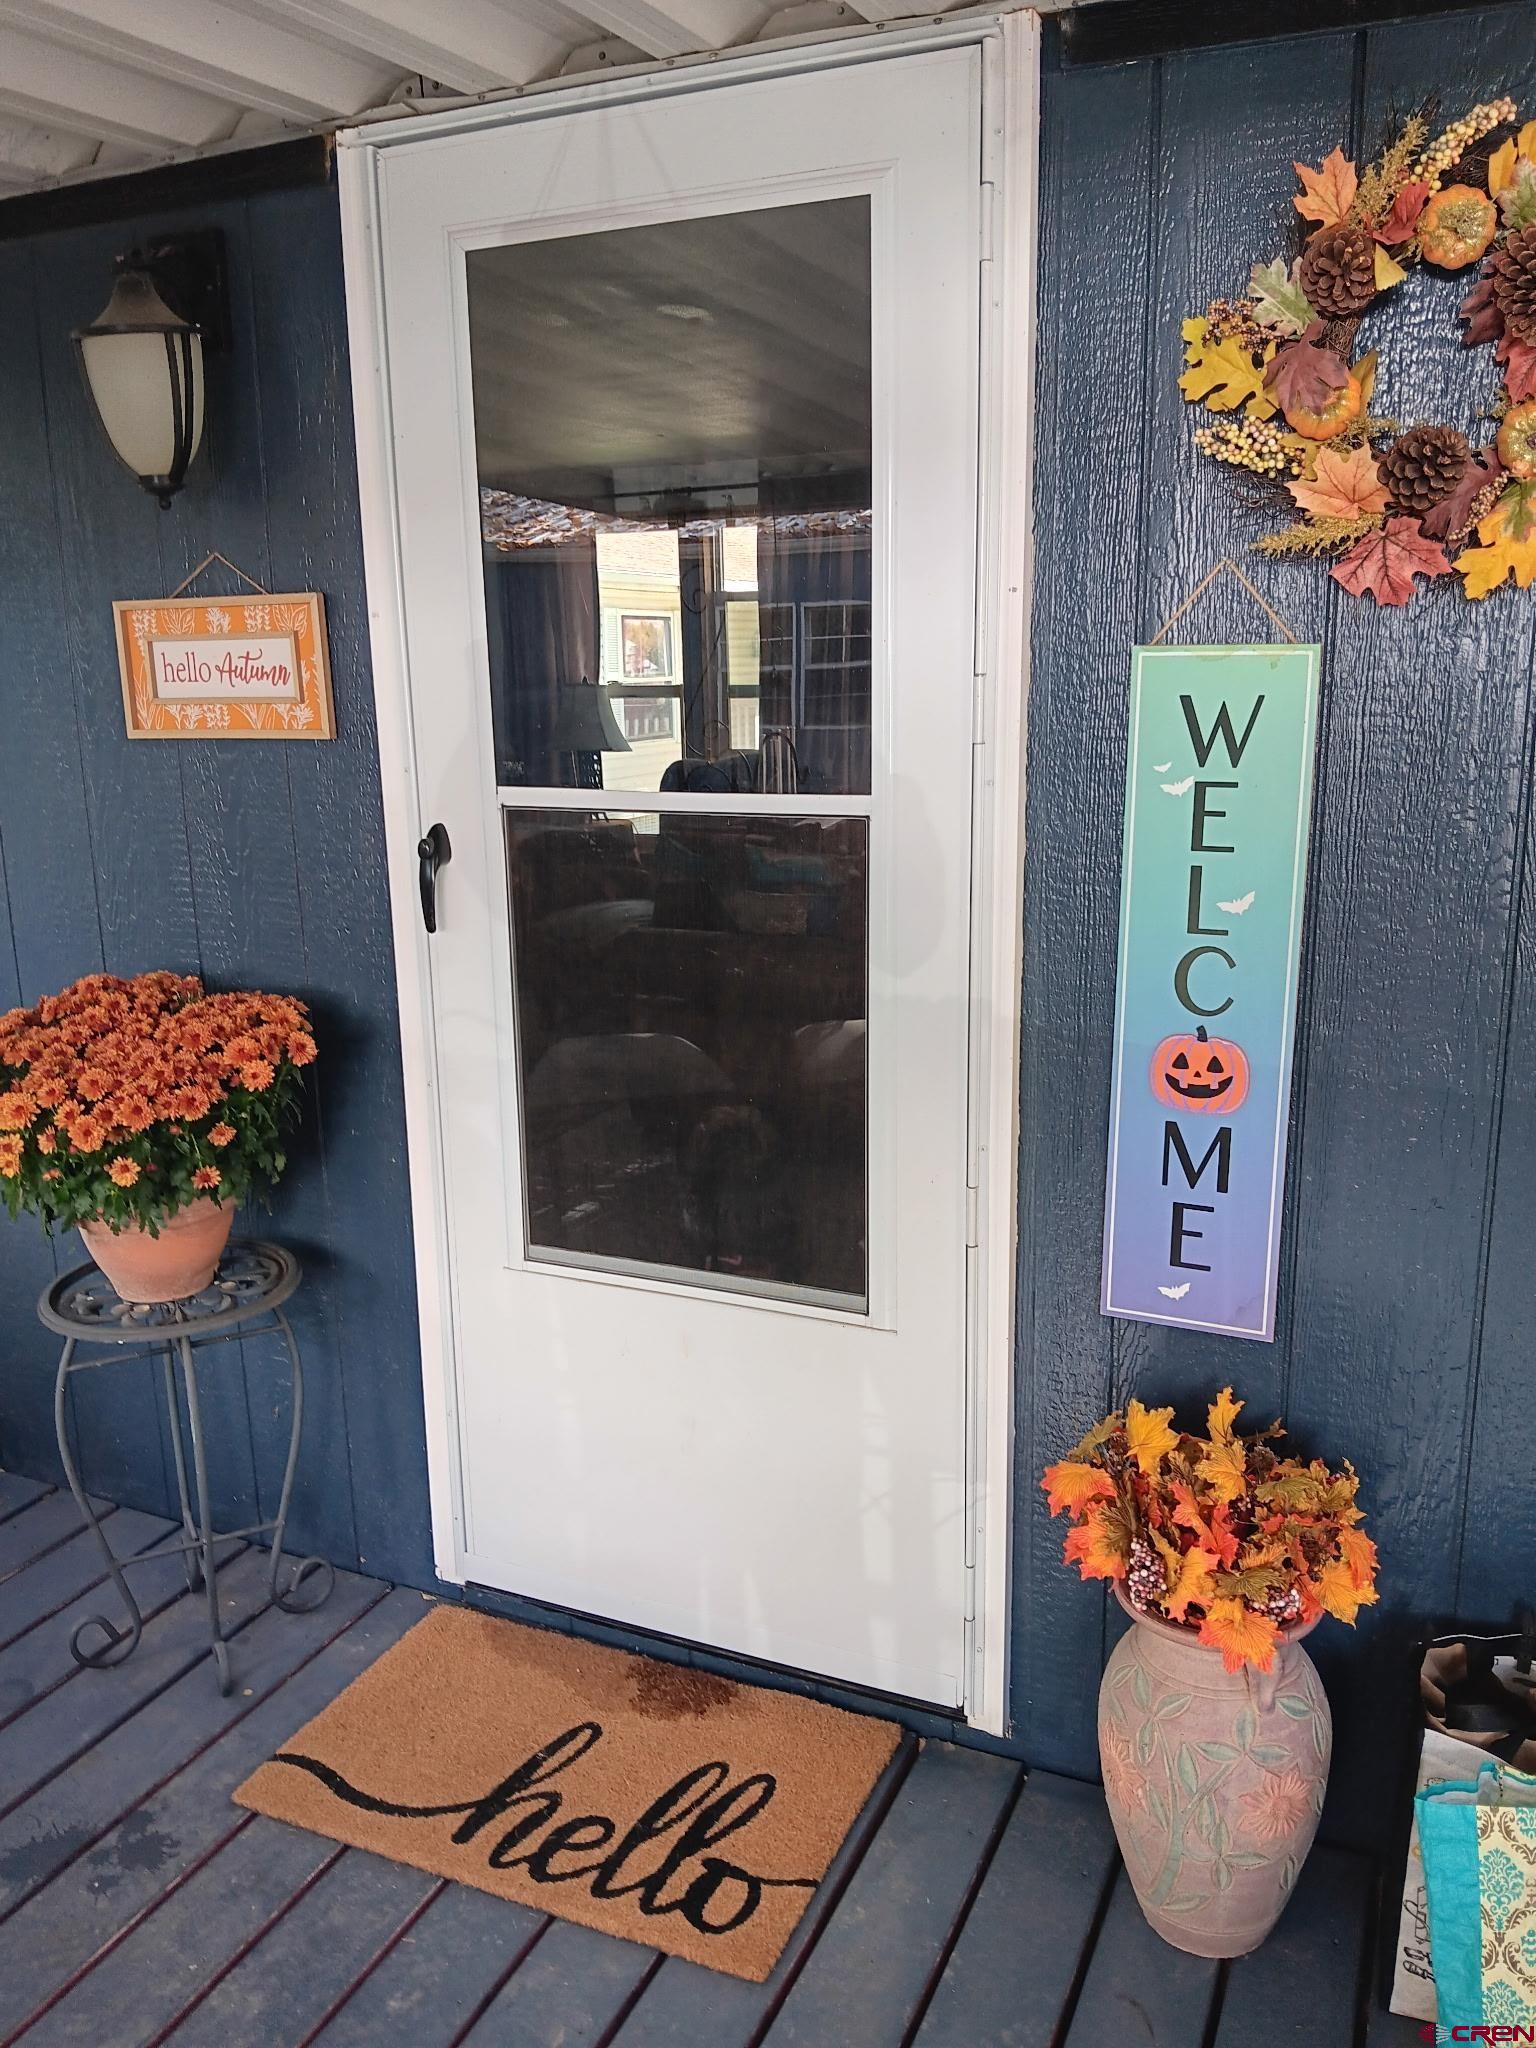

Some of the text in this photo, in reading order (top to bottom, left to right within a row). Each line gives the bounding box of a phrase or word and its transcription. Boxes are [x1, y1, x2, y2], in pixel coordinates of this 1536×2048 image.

[161, 649, 291, 687] hello Autumn
[274, 1722, 820, 1935] hello
